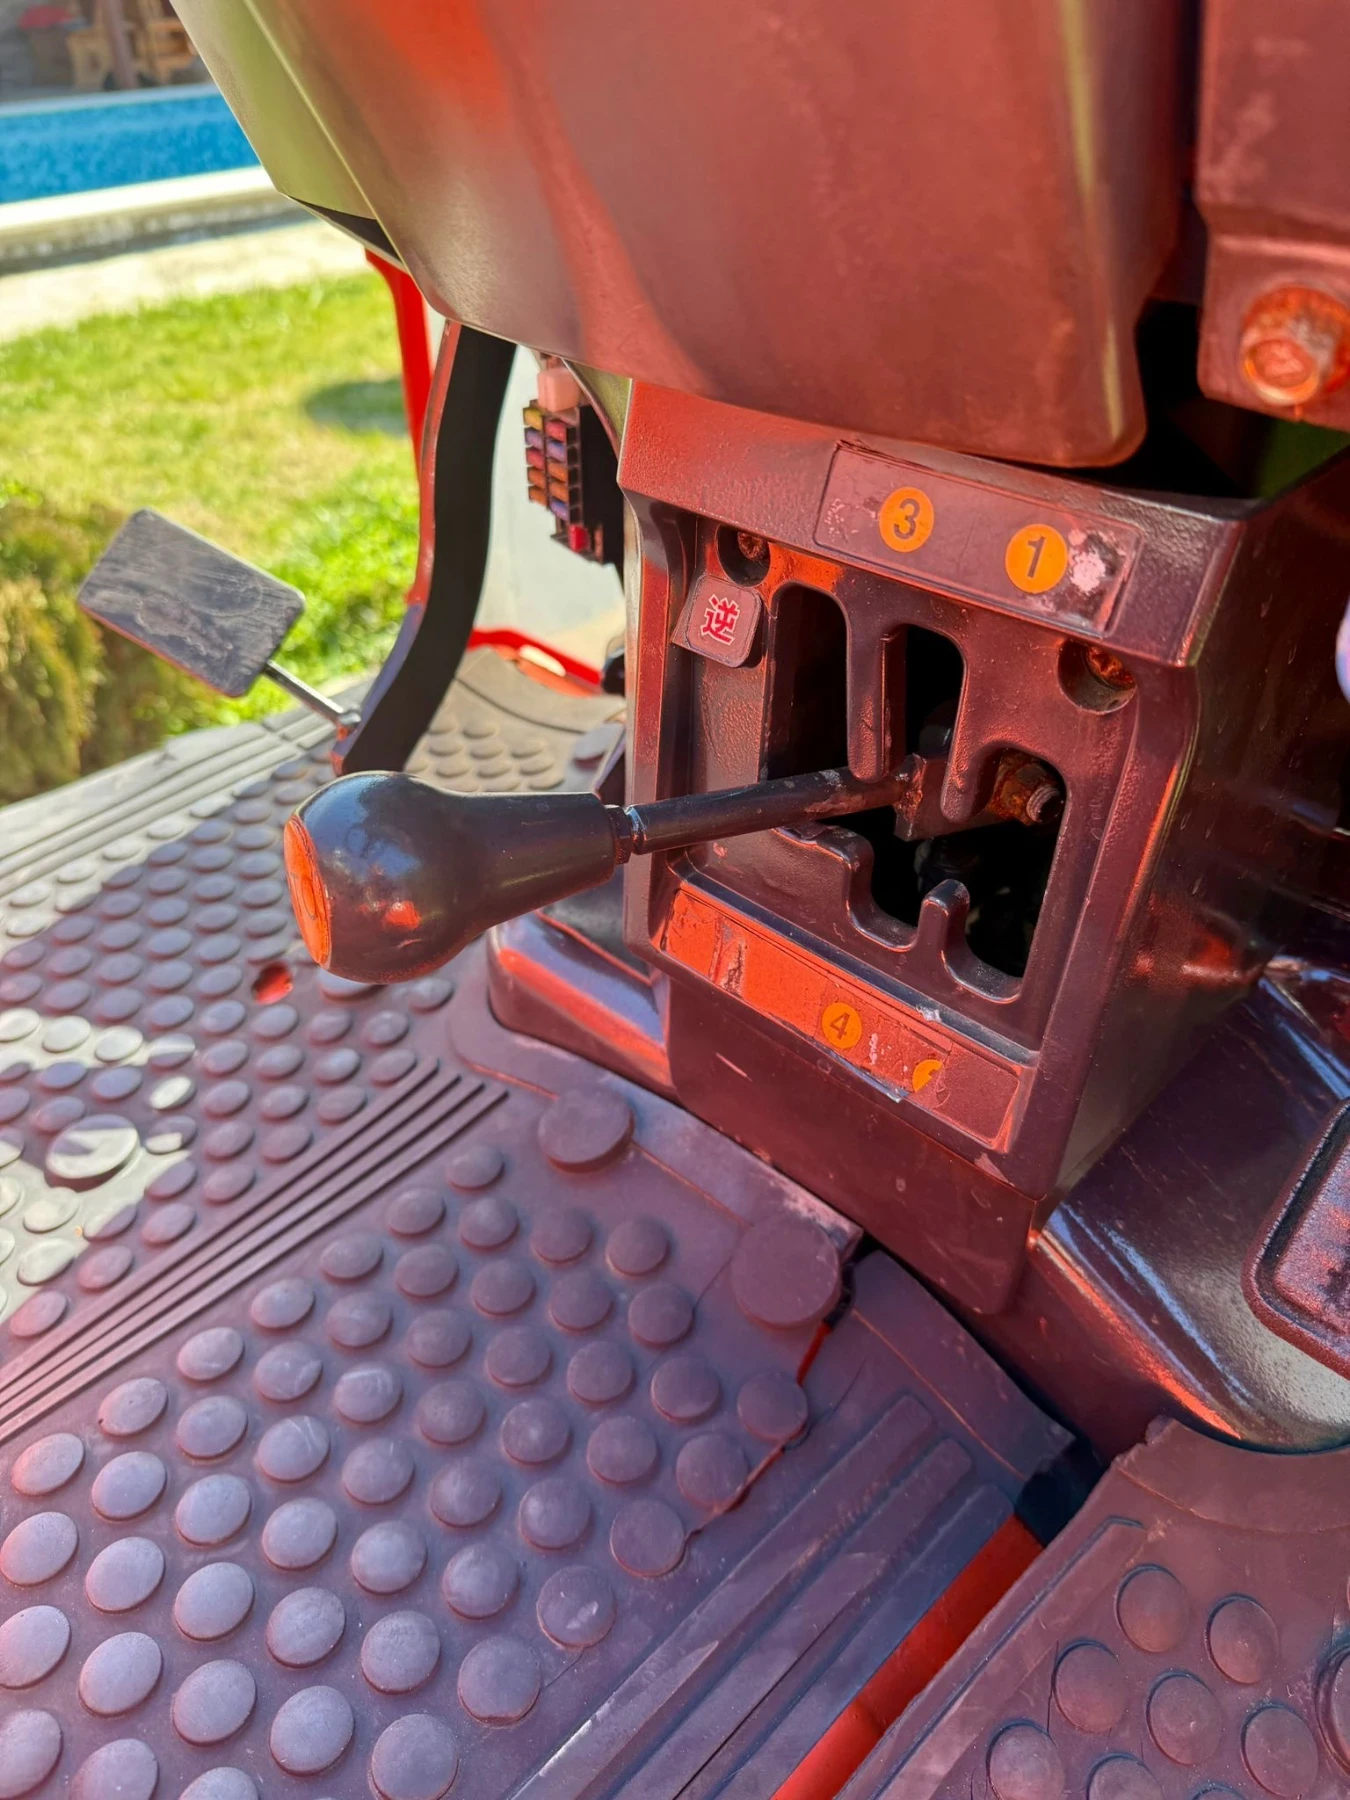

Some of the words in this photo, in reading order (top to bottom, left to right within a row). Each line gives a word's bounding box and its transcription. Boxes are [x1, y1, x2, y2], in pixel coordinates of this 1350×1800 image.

[893, 498, 920, 540] 3
[1027, 536, 1046, 579] 1
[701, 594, 740, 645] 逆
[829, 1012, 851, 1040] 4
